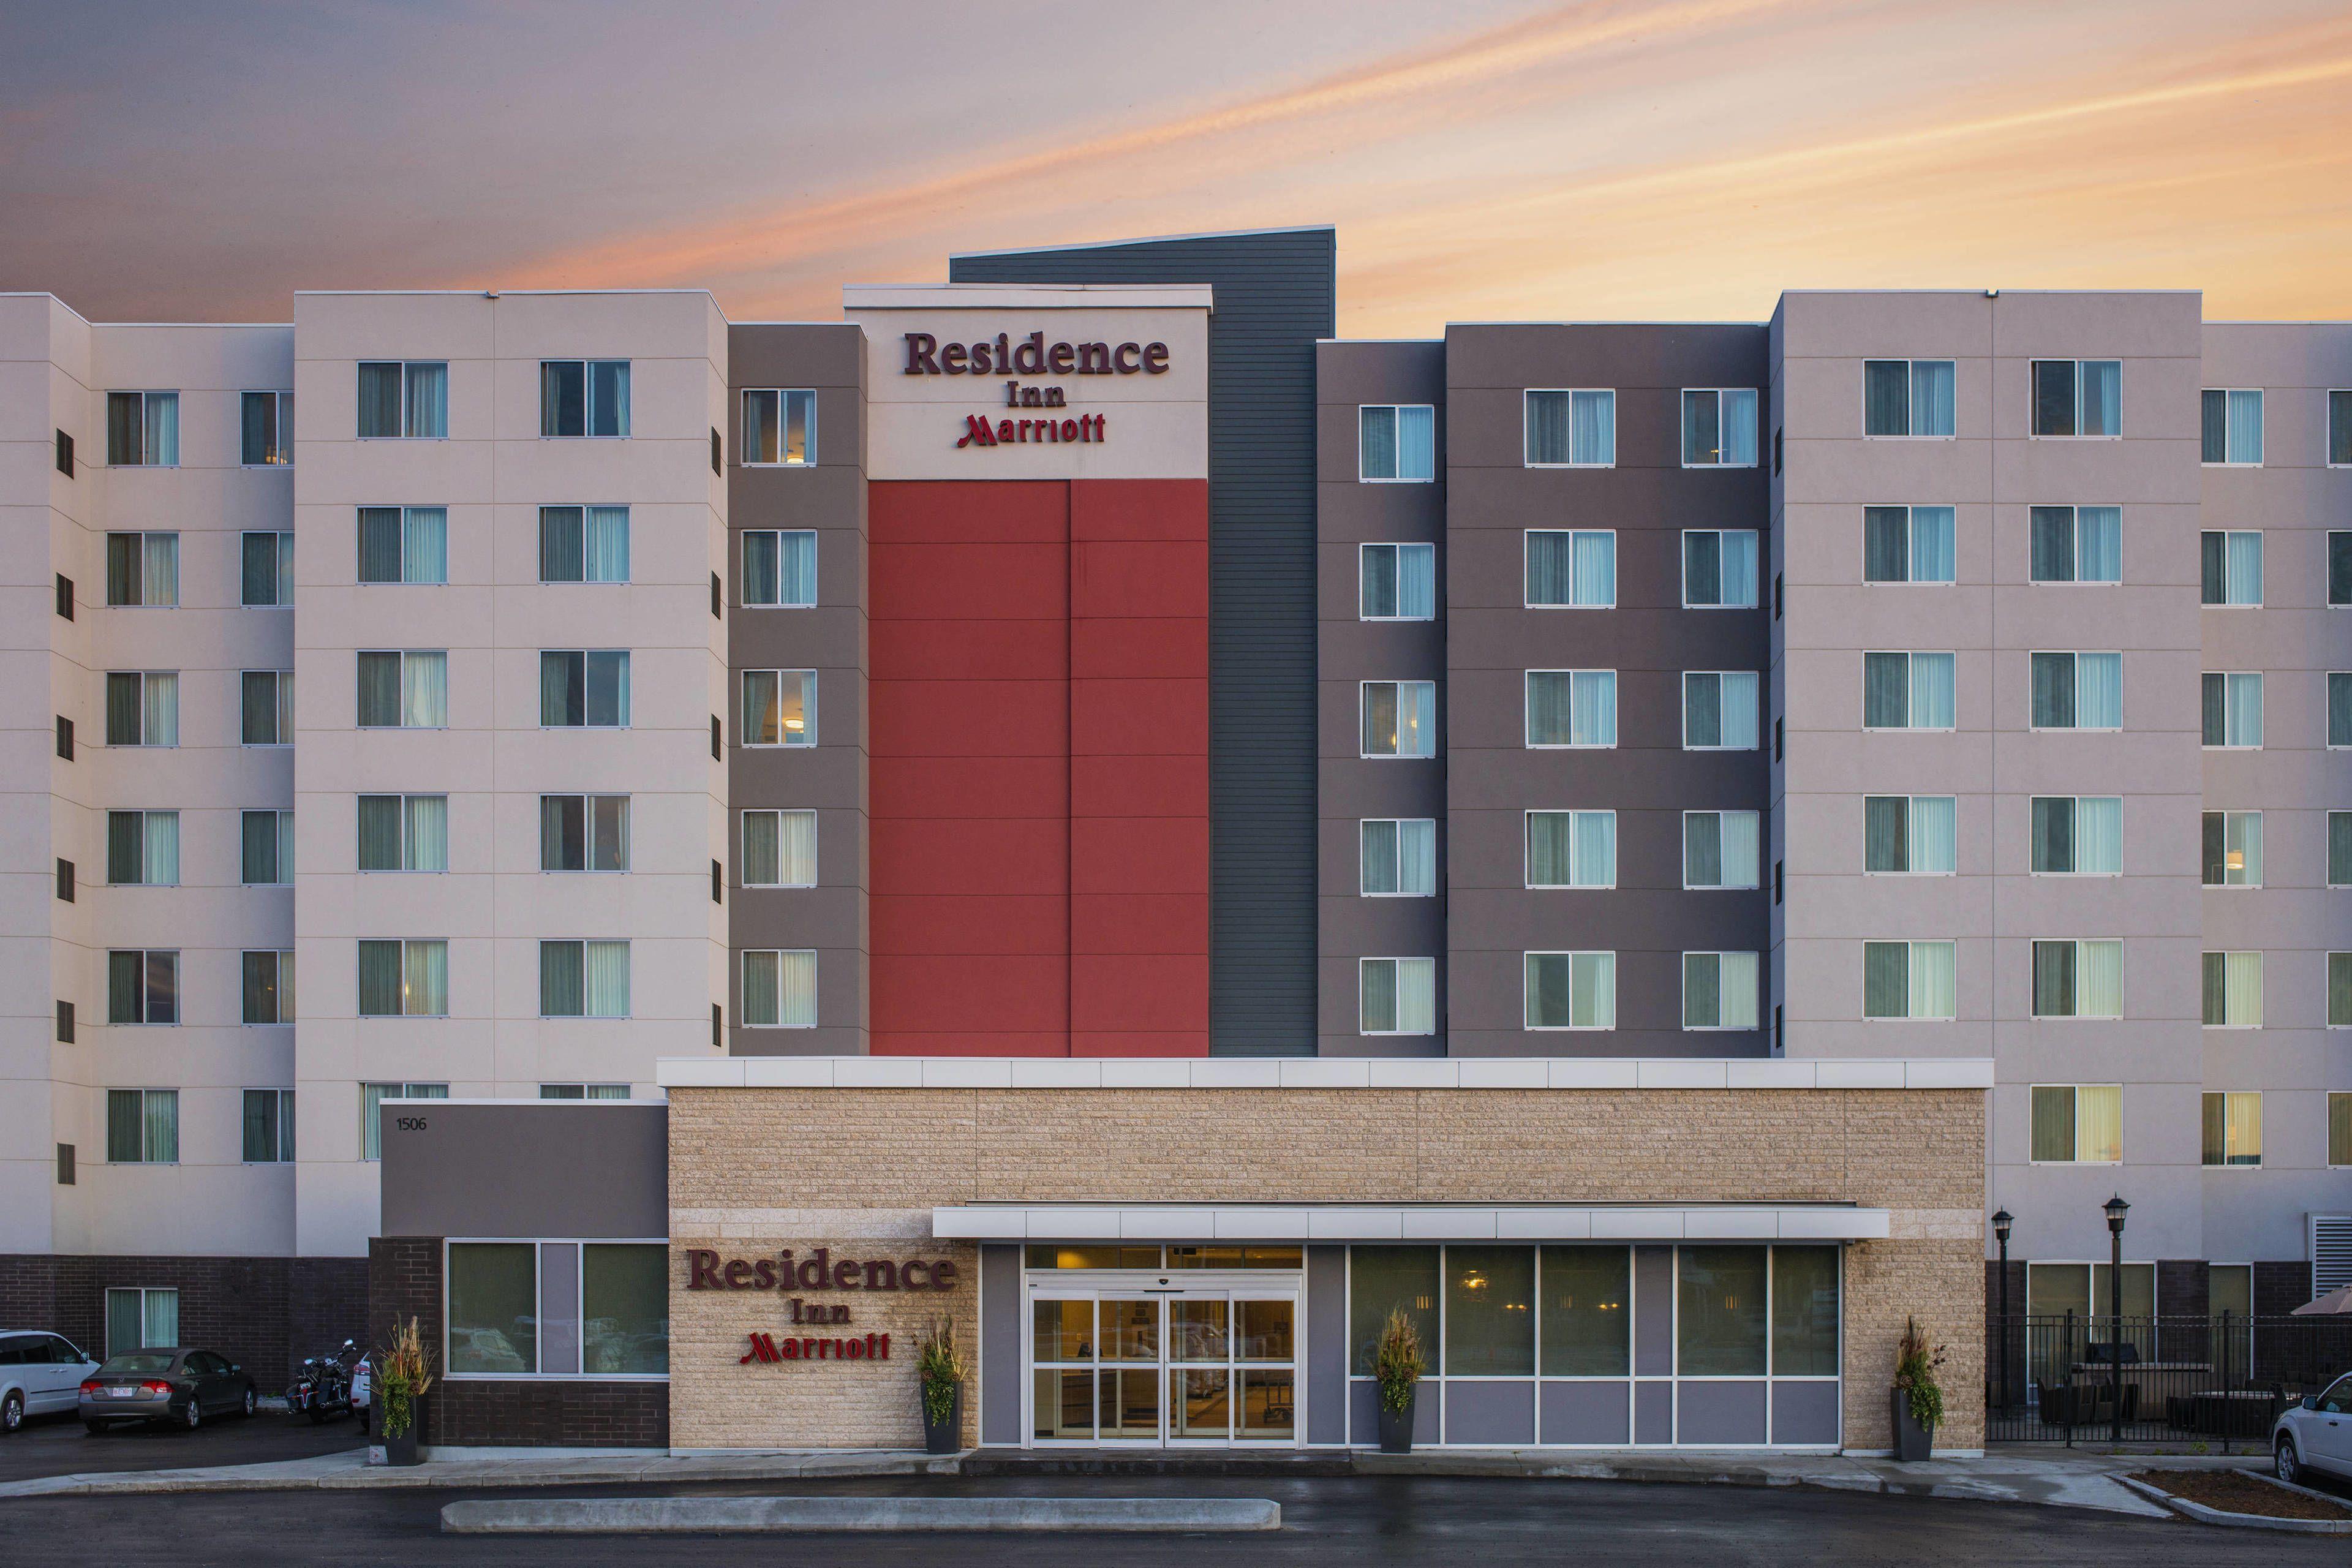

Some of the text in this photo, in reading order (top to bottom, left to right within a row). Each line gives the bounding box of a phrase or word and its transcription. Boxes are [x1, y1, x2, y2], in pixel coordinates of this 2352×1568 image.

[904, 331, 1169, 374] Residence
[1007, 381, 1066, 407] Inn
[957, 413, 1106, 448] Marriott
[396, 1117, 427, 1130] 1506
[686, 1247, 957, 1291] Residence
[790, 1298, 851, 1324] Inn
[739, 1332, 891, 1365] Marriott
